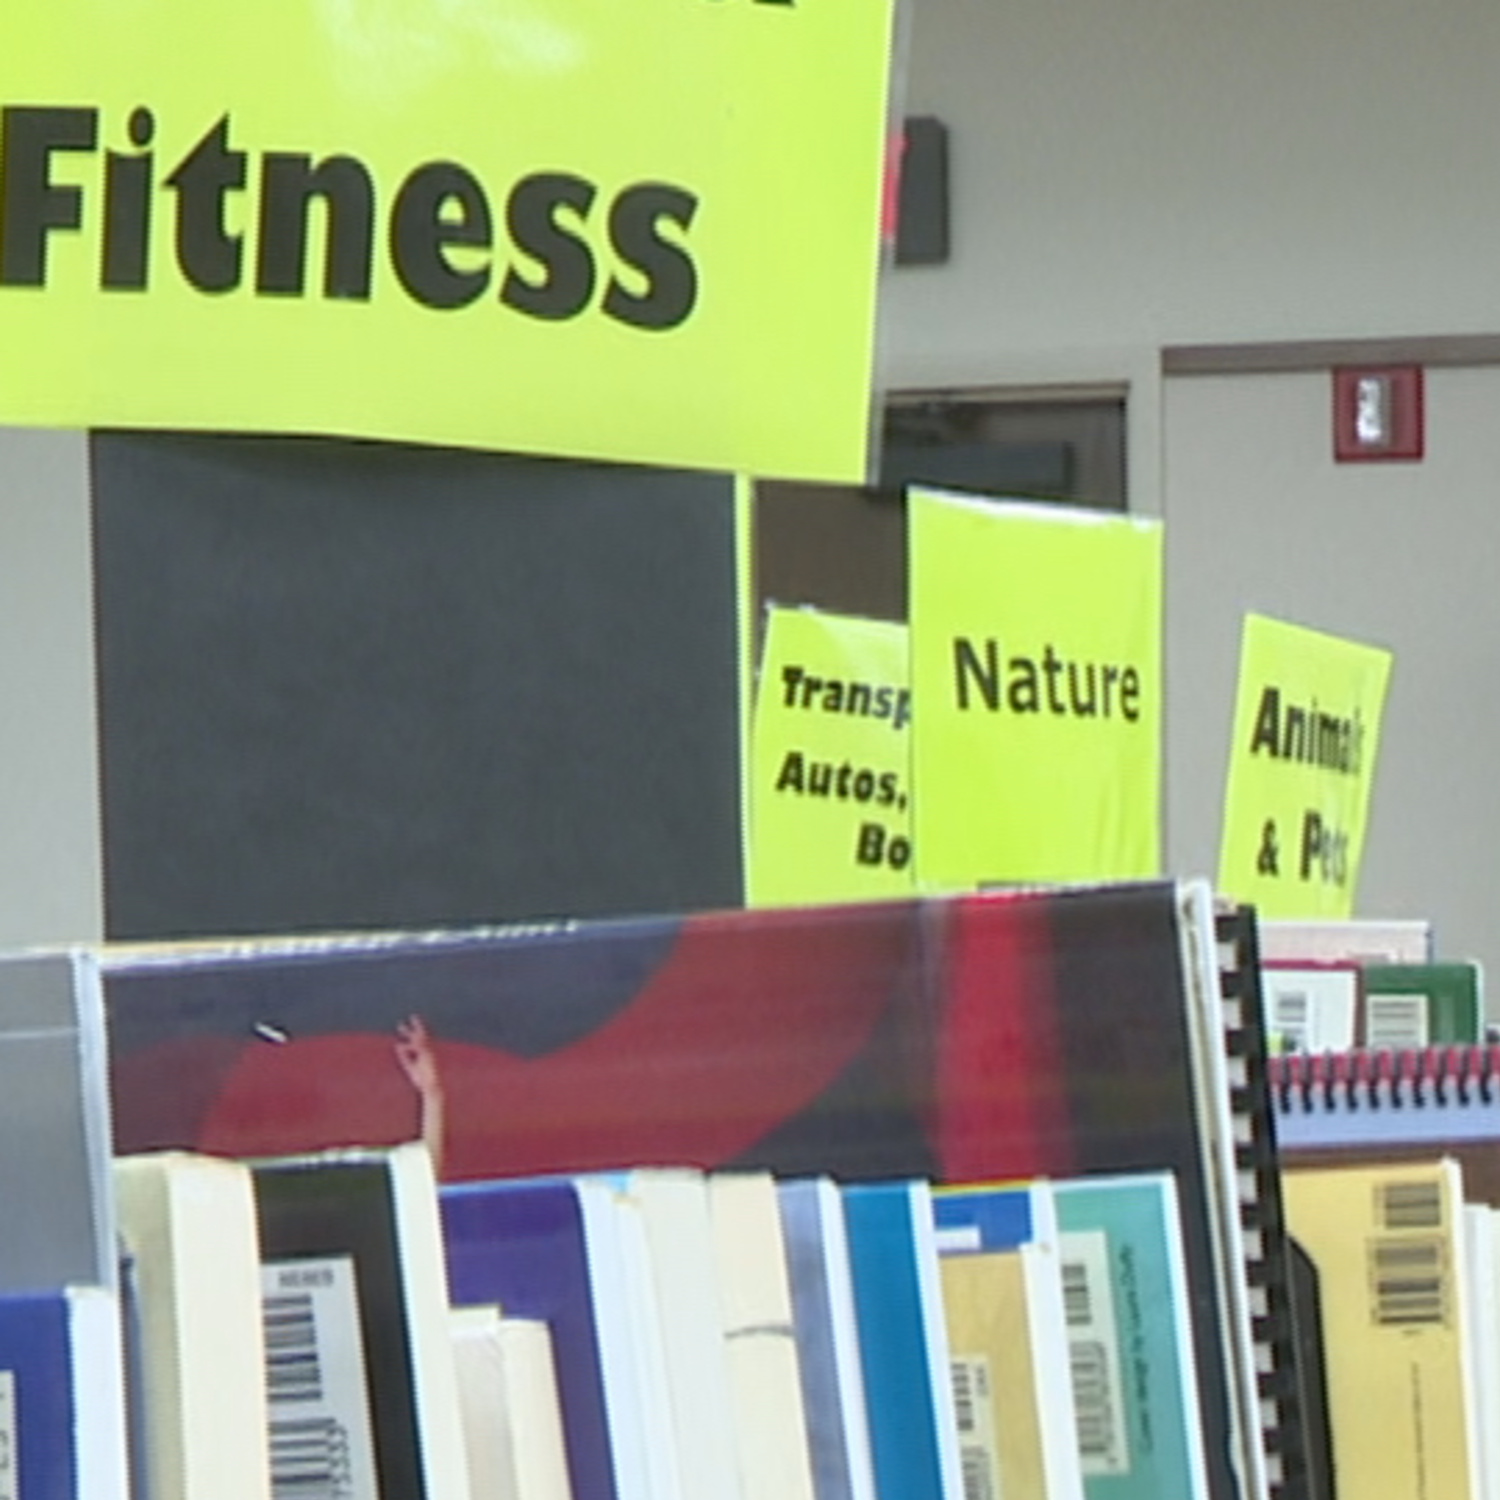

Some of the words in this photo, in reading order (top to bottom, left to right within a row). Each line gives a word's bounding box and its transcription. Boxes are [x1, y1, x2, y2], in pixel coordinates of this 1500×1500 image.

[0, 105, 699, 332] Fitness
[952, 636, 1141, 722] Nature
[775, 750, 907, 814] Autos,
[856, 822, 911, 871] Bo
[1256, 816, 1279, 877] &
